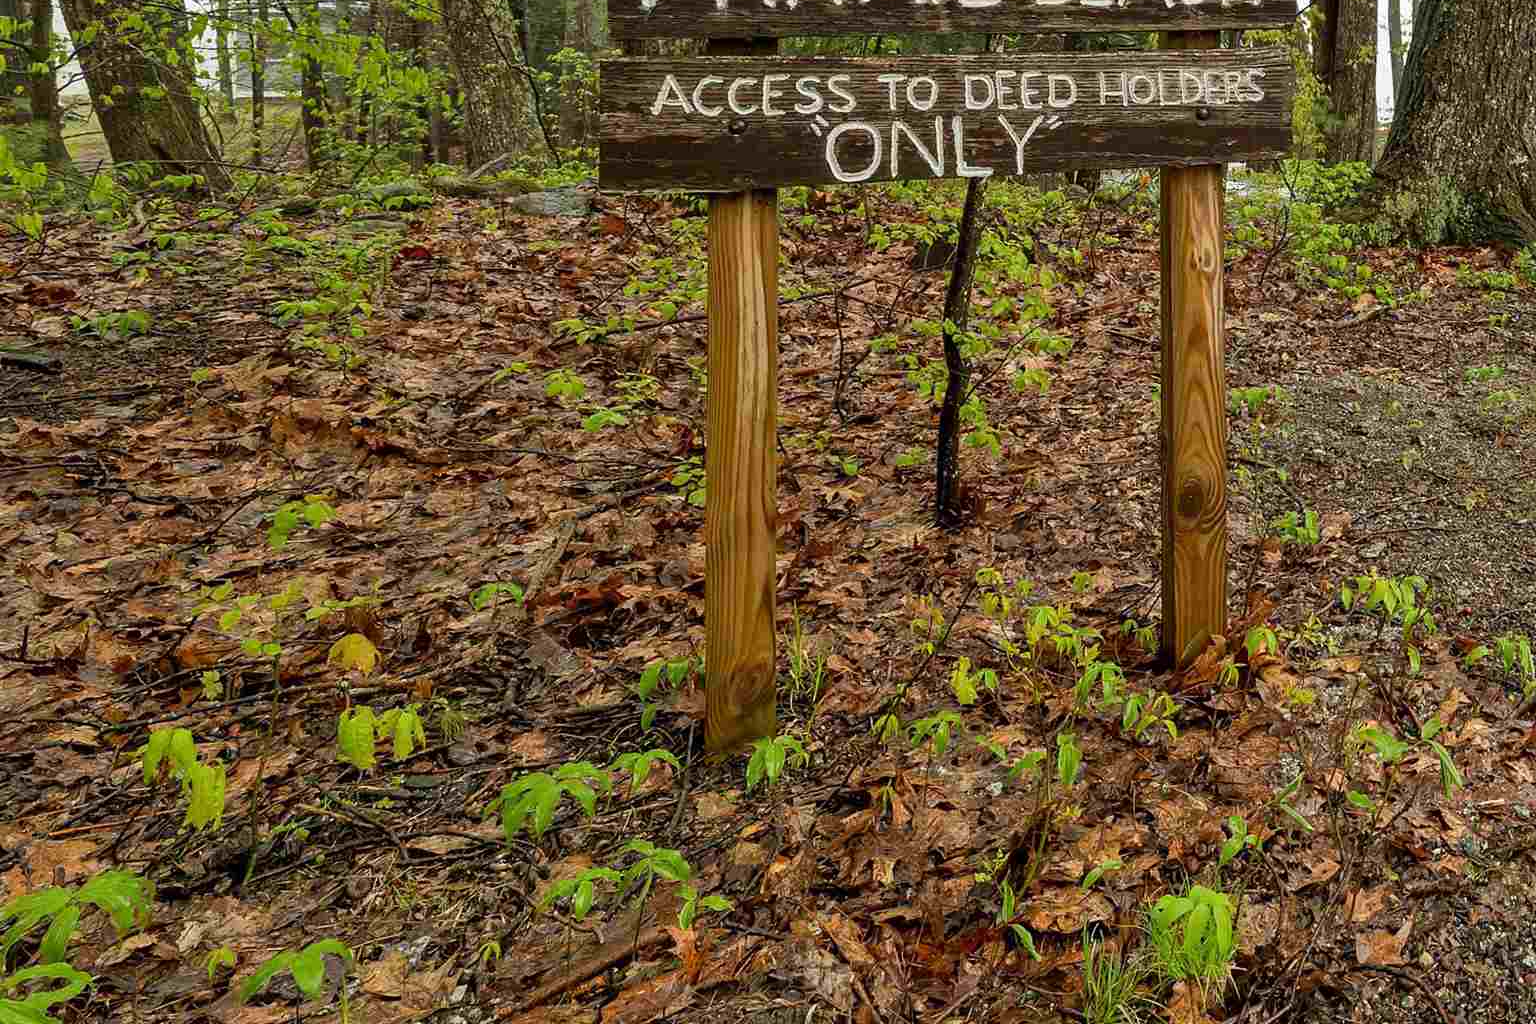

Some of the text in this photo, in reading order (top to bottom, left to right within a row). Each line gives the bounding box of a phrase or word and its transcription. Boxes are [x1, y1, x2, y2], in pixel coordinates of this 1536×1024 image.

[650, 68, 1266, 116] ACCESS TO DEED HOLDERS
